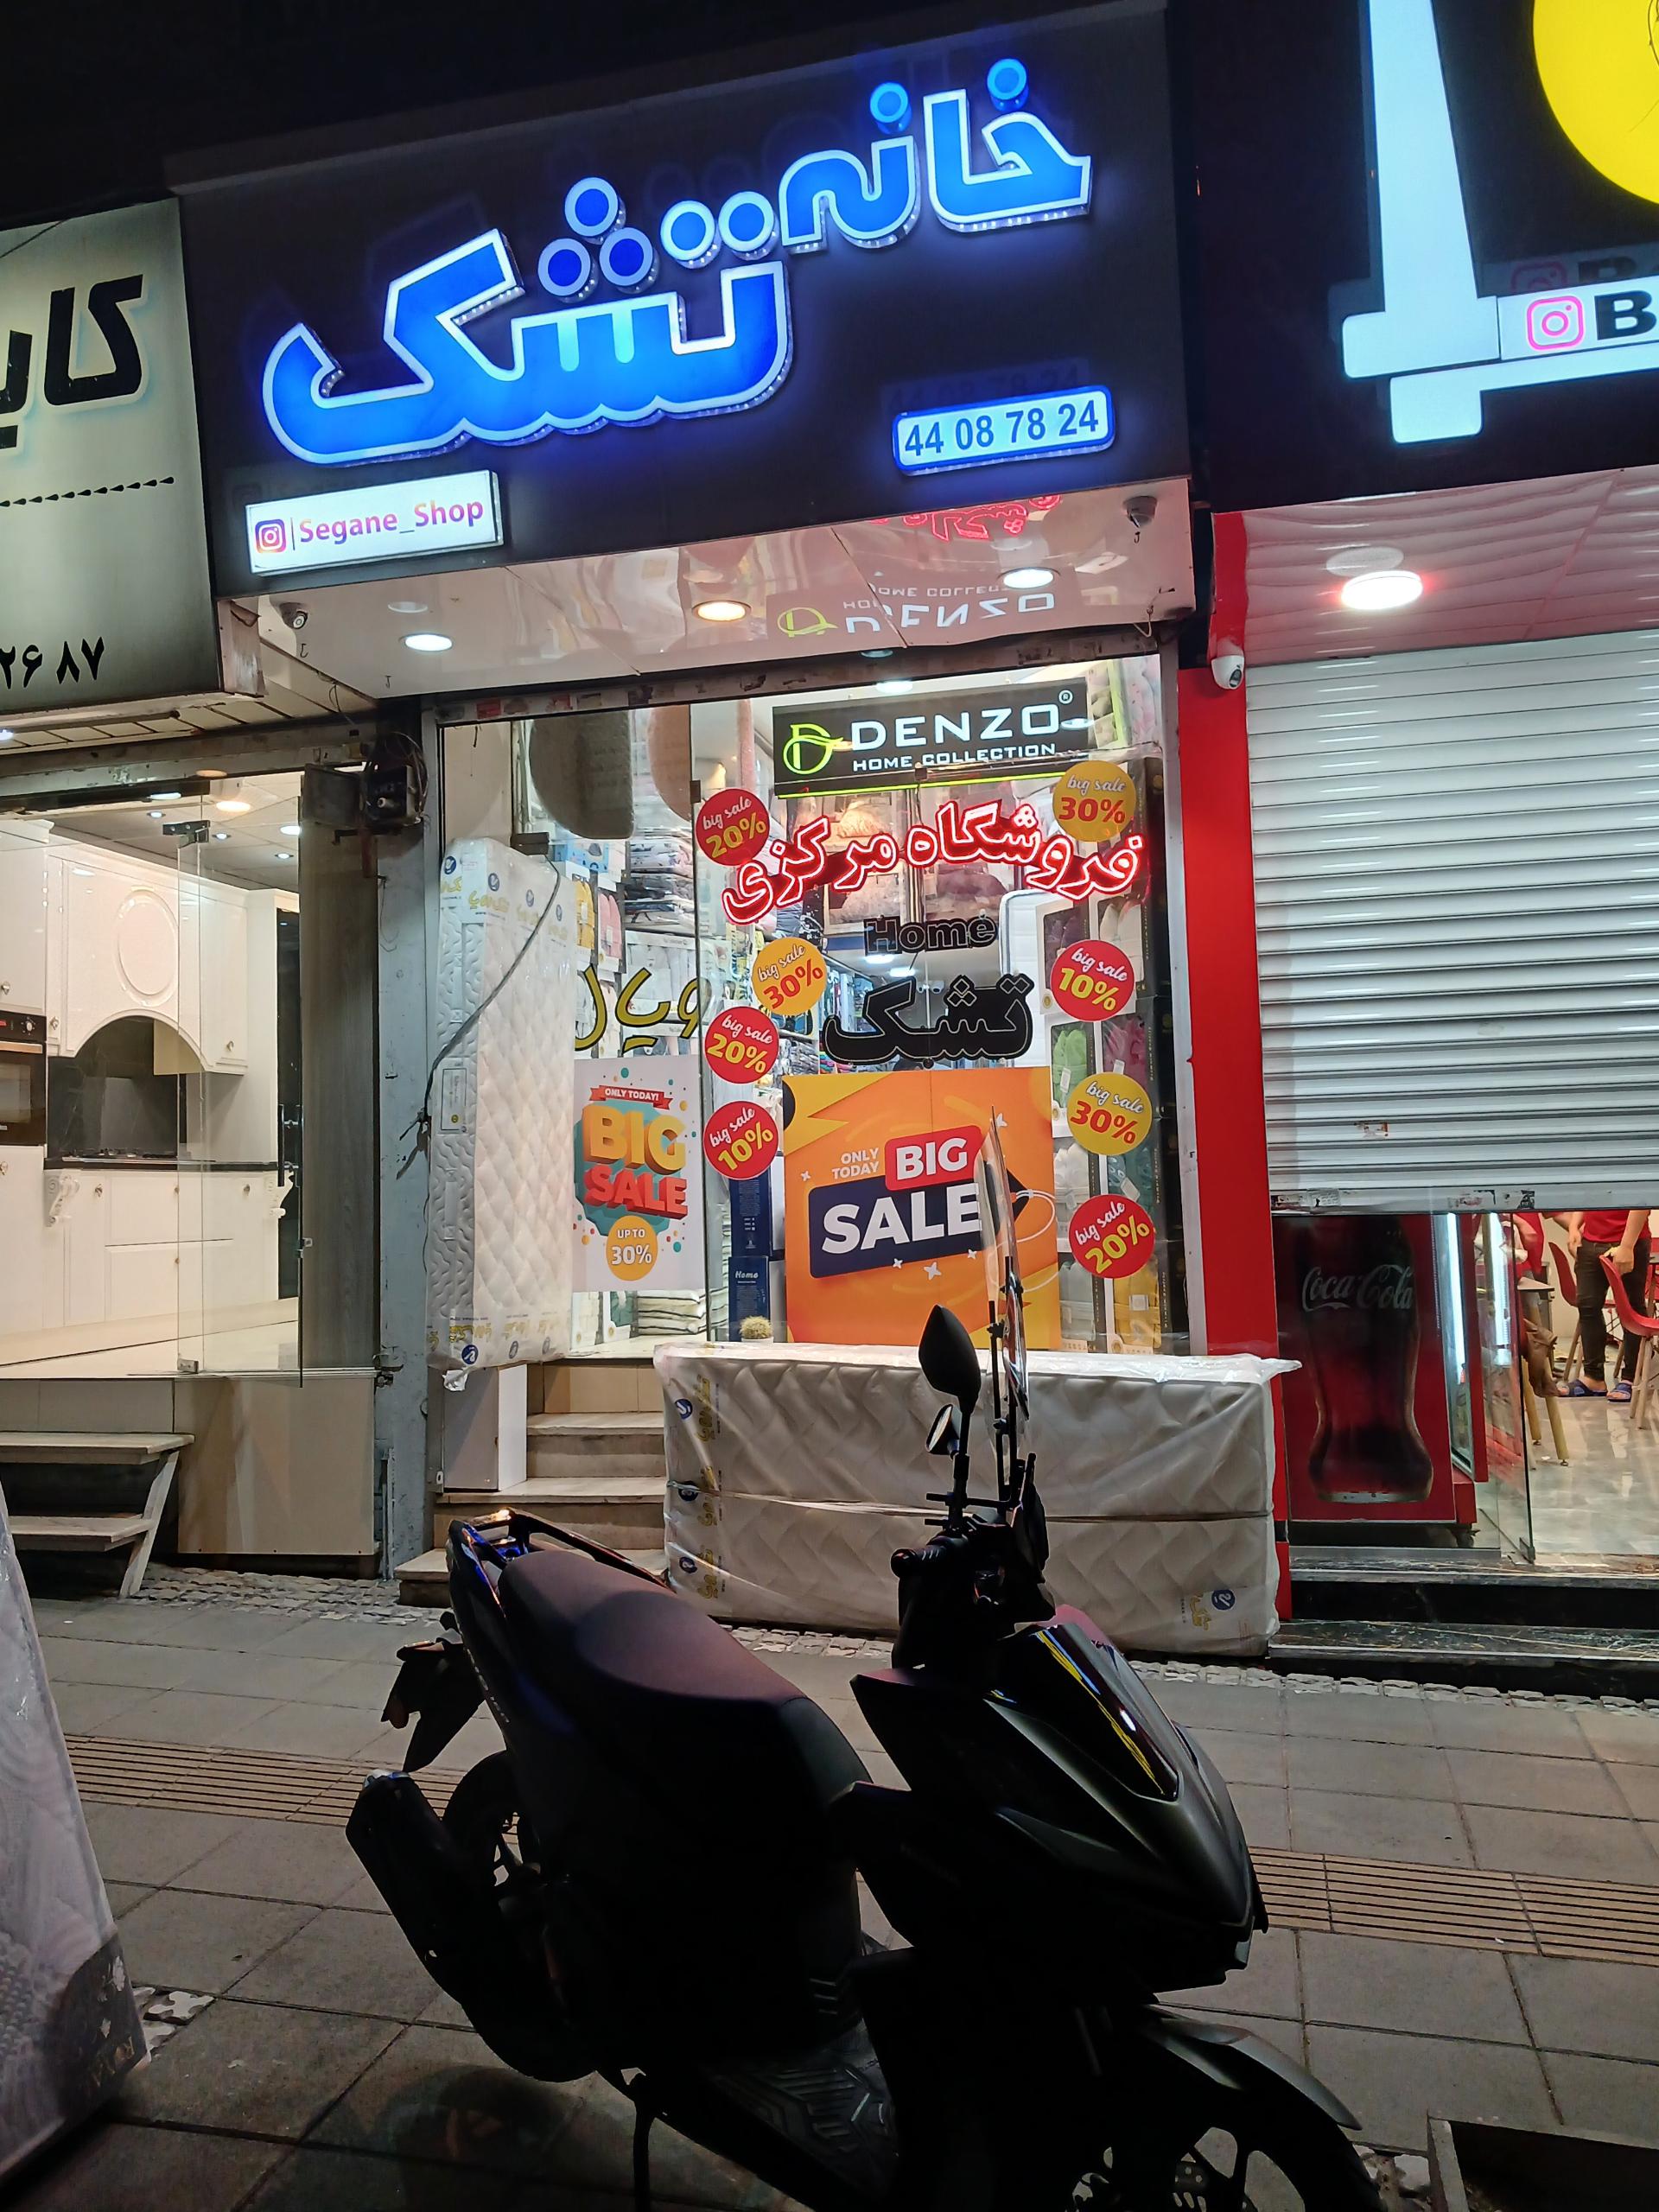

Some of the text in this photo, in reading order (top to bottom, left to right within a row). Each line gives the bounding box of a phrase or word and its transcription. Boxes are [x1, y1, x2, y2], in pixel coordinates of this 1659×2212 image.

[263, 57, 1090, 467] خانه تشک
[905, 400, 1099, 456] 44 08 78 24
[299, 499, 484, 545] Segane_Shop
[56, 636, 105, 685] ۸۷
[853, 742, 1056, 772] HOME COLLECTION
[1066, 774, 1126, 797] big sale
[702, 795, 753, 831] big sale
[1058, 797, 1126, 824] 30%
[705, 812, 767, 859] 20%
[722, 798, 1146, 923] فروشگاه مرکزی
[865, 913, 998, 954] Home
[758, 944, 805, 982] big sale
[763, 959, 823, 1009] 30%
[1071, 946, 1128, 982] big sale
[1058, 967, 1117, 1012] 10%
[721, 1014, 773, 1046] big sale
[821, 974, 1034, 1065] تشک
[705, 1033, 767, 1075] 20%
[604, 1087, 659, 1102] ONLY TODAY!
[1085, 1080, 1145, 1115] big sale
[582, 1103, 687, 1175] BIG
[709, 1107, 755, 1148] big sale
[1069, 1099, 1138, 1145] 30%
[717, 1122, 773, 1172] 10%
[840, 1147, 880, 1165] ONLY
[895, 1136, 969, 1181] BIG
[584, 1165, 690, 1220] SALE
[831, 1160, 880, 1180] TODAY
[821, 1181, 983, 1255] SALE
[1074, 1200, 1126, 1246] big sale
[610, 1244, 652, 1266] 30%
[1084, 1215, 1150, 1274] 20%
[1301, 1263, 1414, 1313] Coca-Cola
